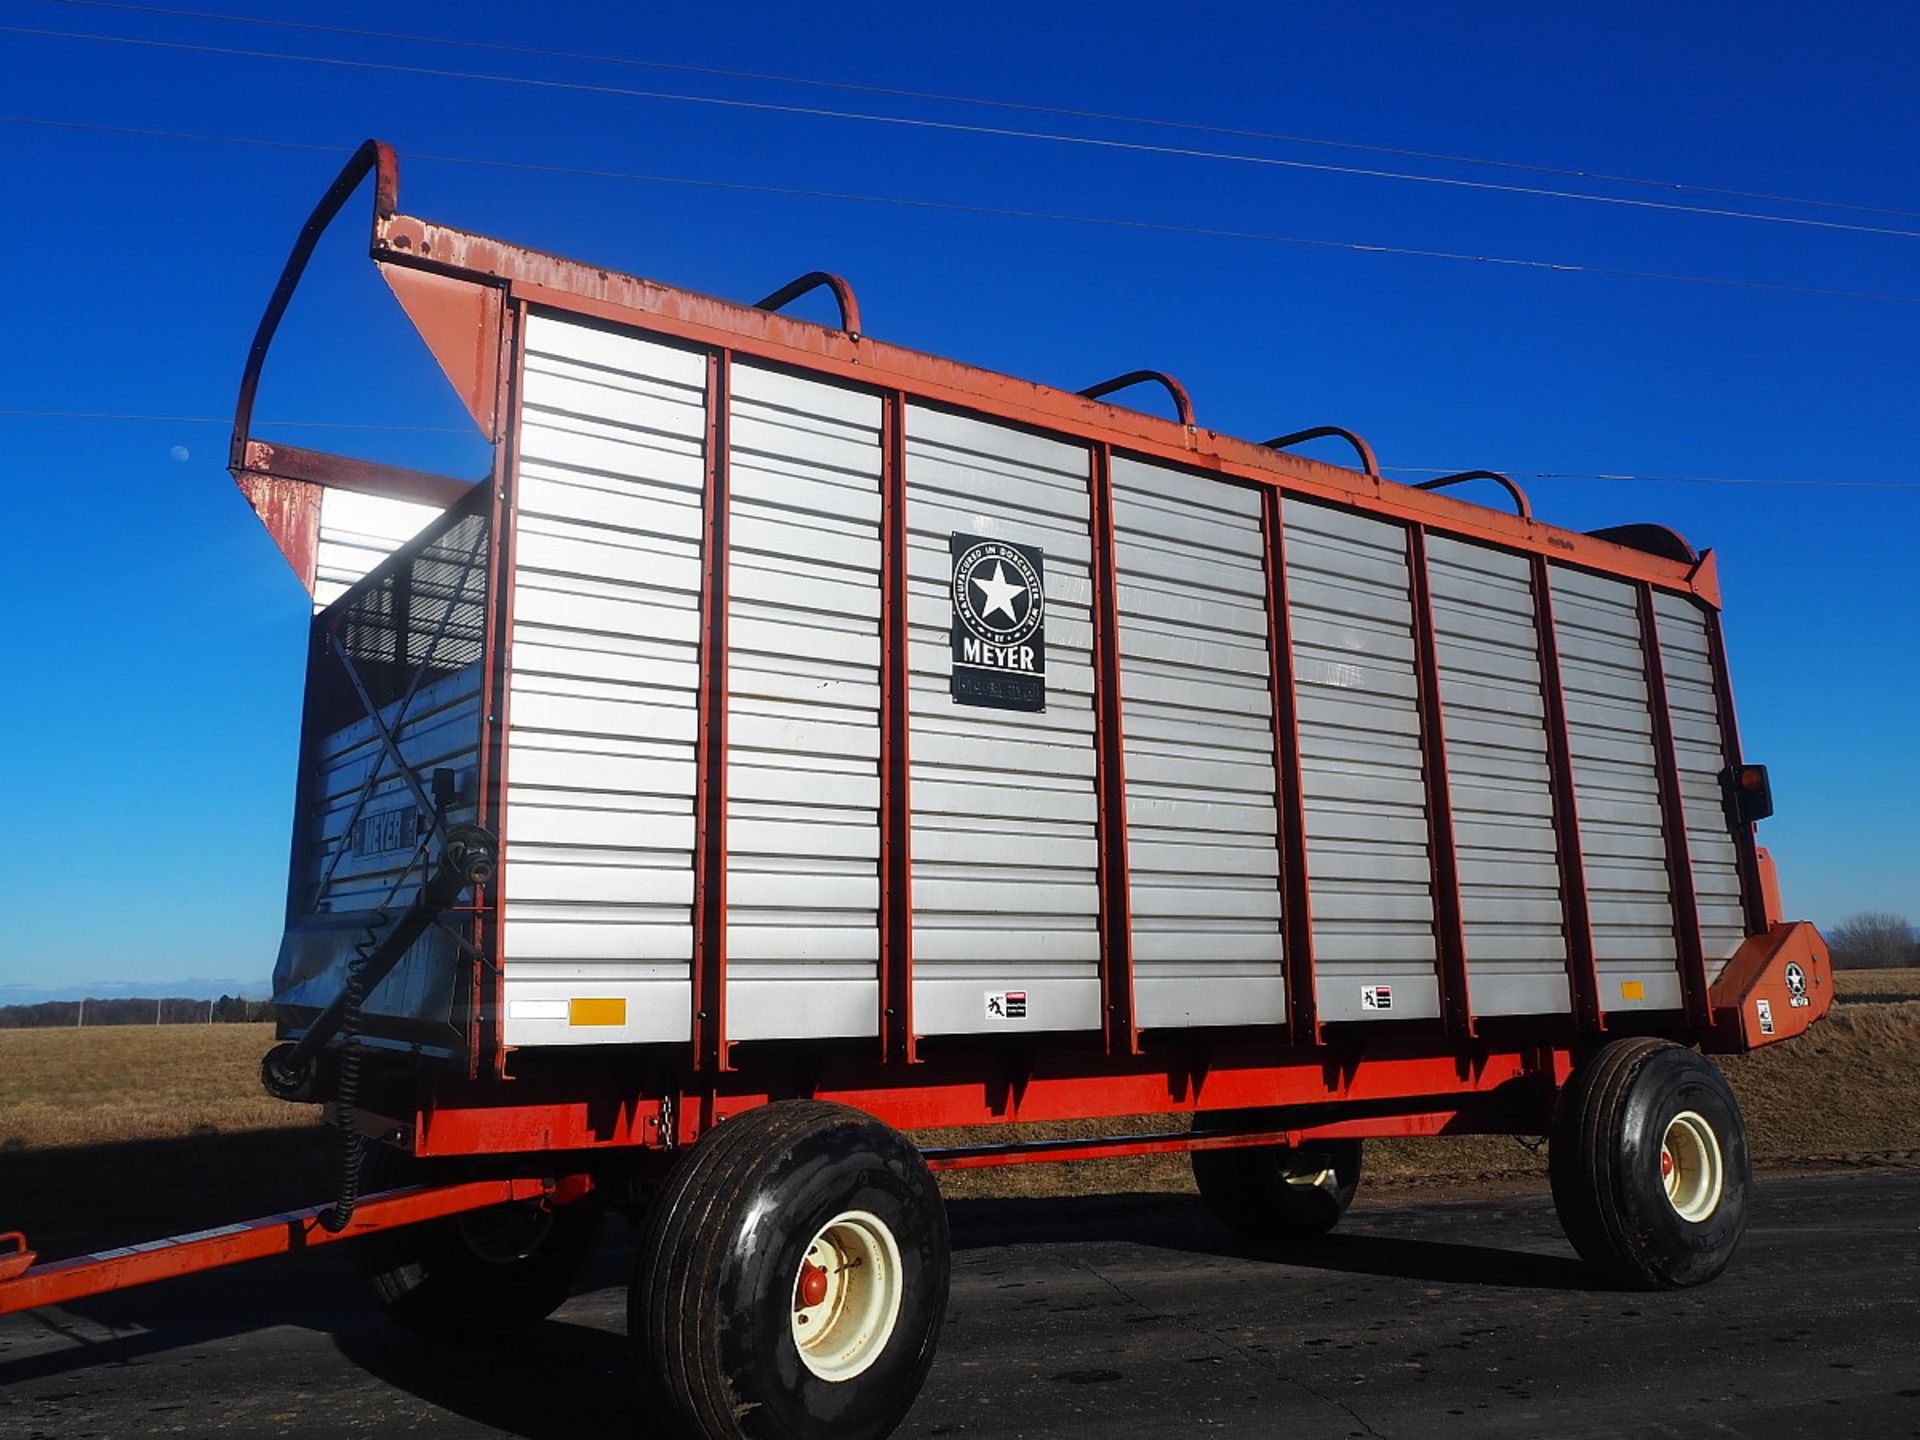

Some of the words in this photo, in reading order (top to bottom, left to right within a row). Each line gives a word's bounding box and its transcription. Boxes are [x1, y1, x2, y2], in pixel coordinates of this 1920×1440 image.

[985, 546, 996, 555] IN
[1000, 547, 1040, 599] DORCHESTER
[963, 636, 1035, 671] MEYER
[365, 811, 401, 854] MEYER
